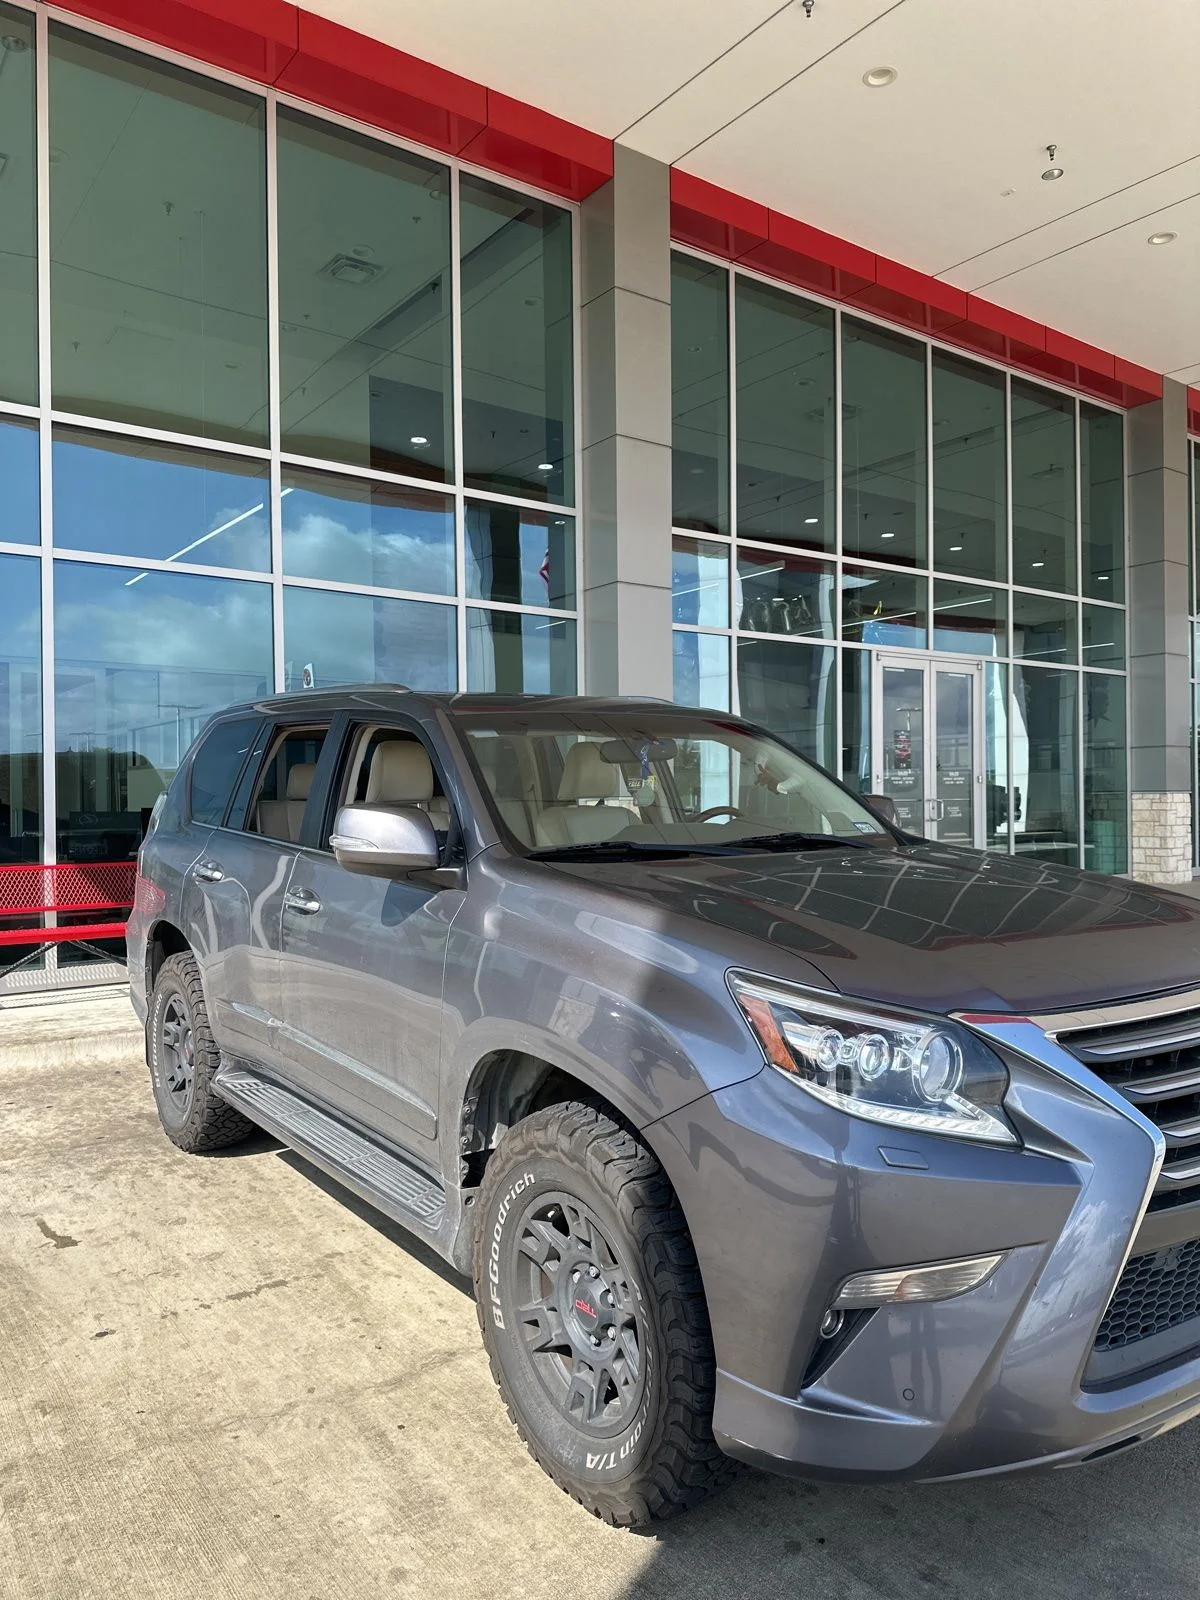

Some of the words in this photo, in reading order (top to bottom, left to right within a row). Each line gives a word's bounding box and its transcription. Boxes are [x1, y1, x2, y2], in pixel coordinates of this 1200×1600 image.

[488, 1172, 536, 1330] BFGoodrich
[575, 1299, 597, 1318] TRD
[585, 1451, 617, 1470] T/A
